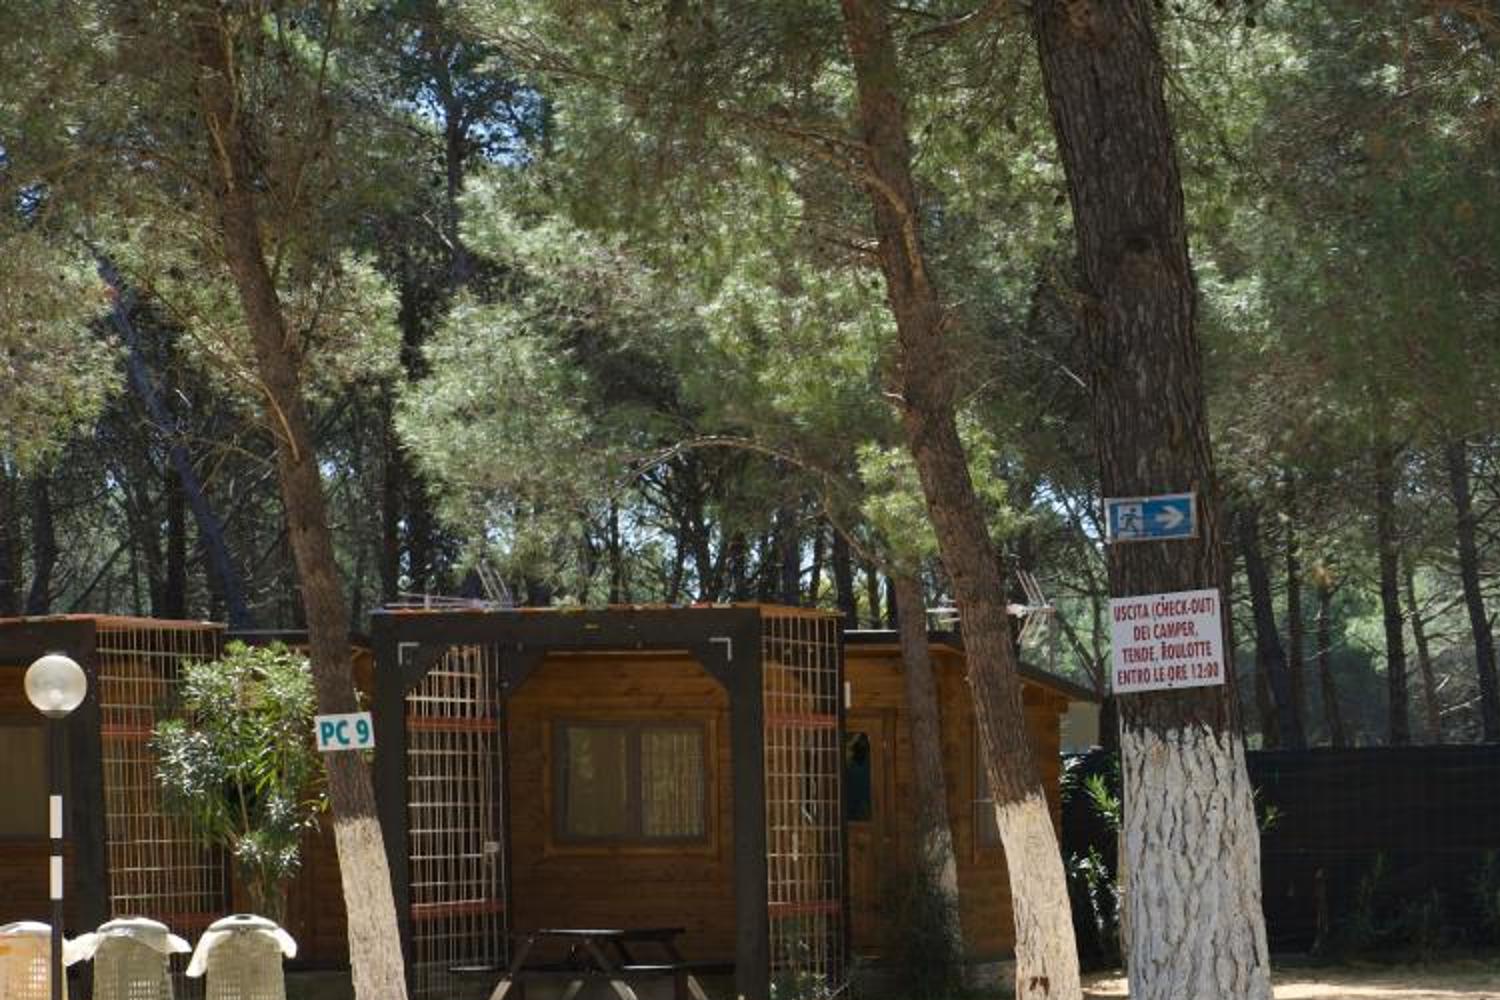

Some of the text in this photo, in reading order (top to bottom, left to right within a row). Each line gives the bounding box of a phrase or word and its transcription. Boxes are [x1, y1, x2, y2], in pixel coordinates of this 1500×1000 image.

[1114, 598, 1215, 621] USCITA (CHECK-OUT)
[1133, 626, 1150, 641] DEI
[1161, 641, 1212, 660] ROULOTTE
[1118, 661, 1219, 685] ENTRO LE ORE 12:00
[320, 719, 369, 746] PC 9
